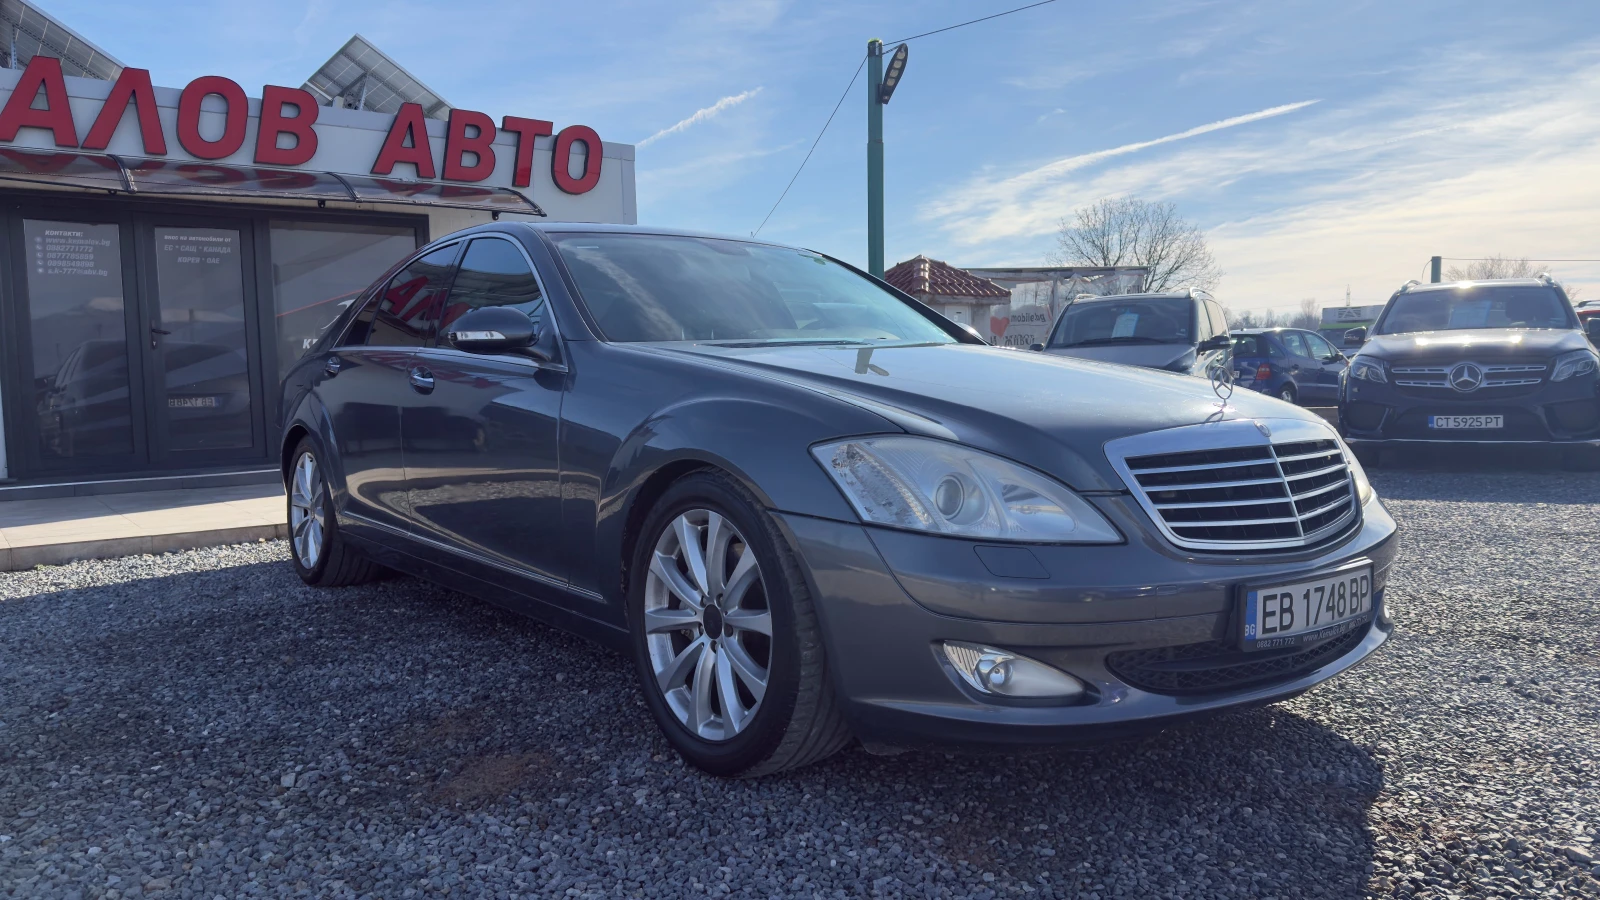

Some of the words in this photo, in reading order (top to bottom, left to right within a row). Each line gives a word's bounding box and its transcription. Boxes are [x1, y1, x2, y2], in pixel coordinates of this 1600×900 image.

[0, 55, 319, 165] АЛОВ
[371, 103, 603, 195] АВТО
[1436, 416, 1451, 428] CT
[1453, 416, 1483, 428] 5925
[1485, 416, 1501, 427] PT
[1262, 592, 1294, 634] EB
[1303, 581, 1347, 627] 1748
[1350, 574, 1369, 615] BP
[1244, 624, 1256, 637] BG
